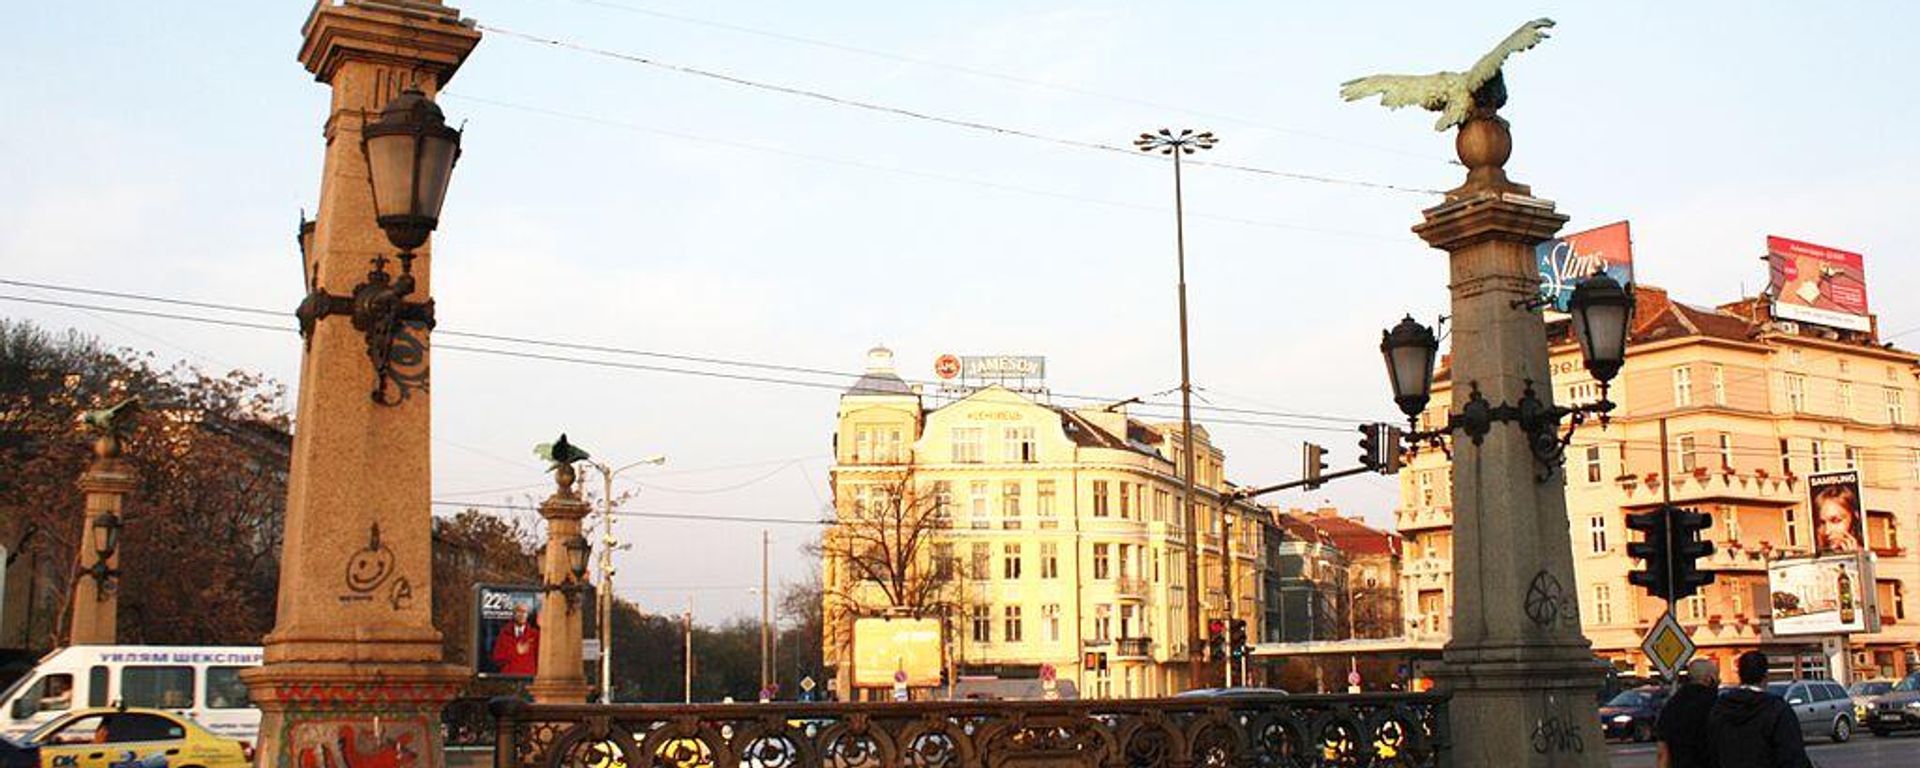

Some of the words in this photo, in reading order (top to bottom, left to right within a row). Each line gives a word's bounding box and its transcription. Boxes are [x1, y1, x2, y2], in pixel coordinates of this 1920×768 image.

[1553, 240, 1608, 297] Slims
[970, 357, 1038, 374] JAMESON
[1811, 474, 1855, 486] SAMSUNG
[483, 591, 513, 610] 22%
[101, 653, 168, 662] УИЛЯМ
